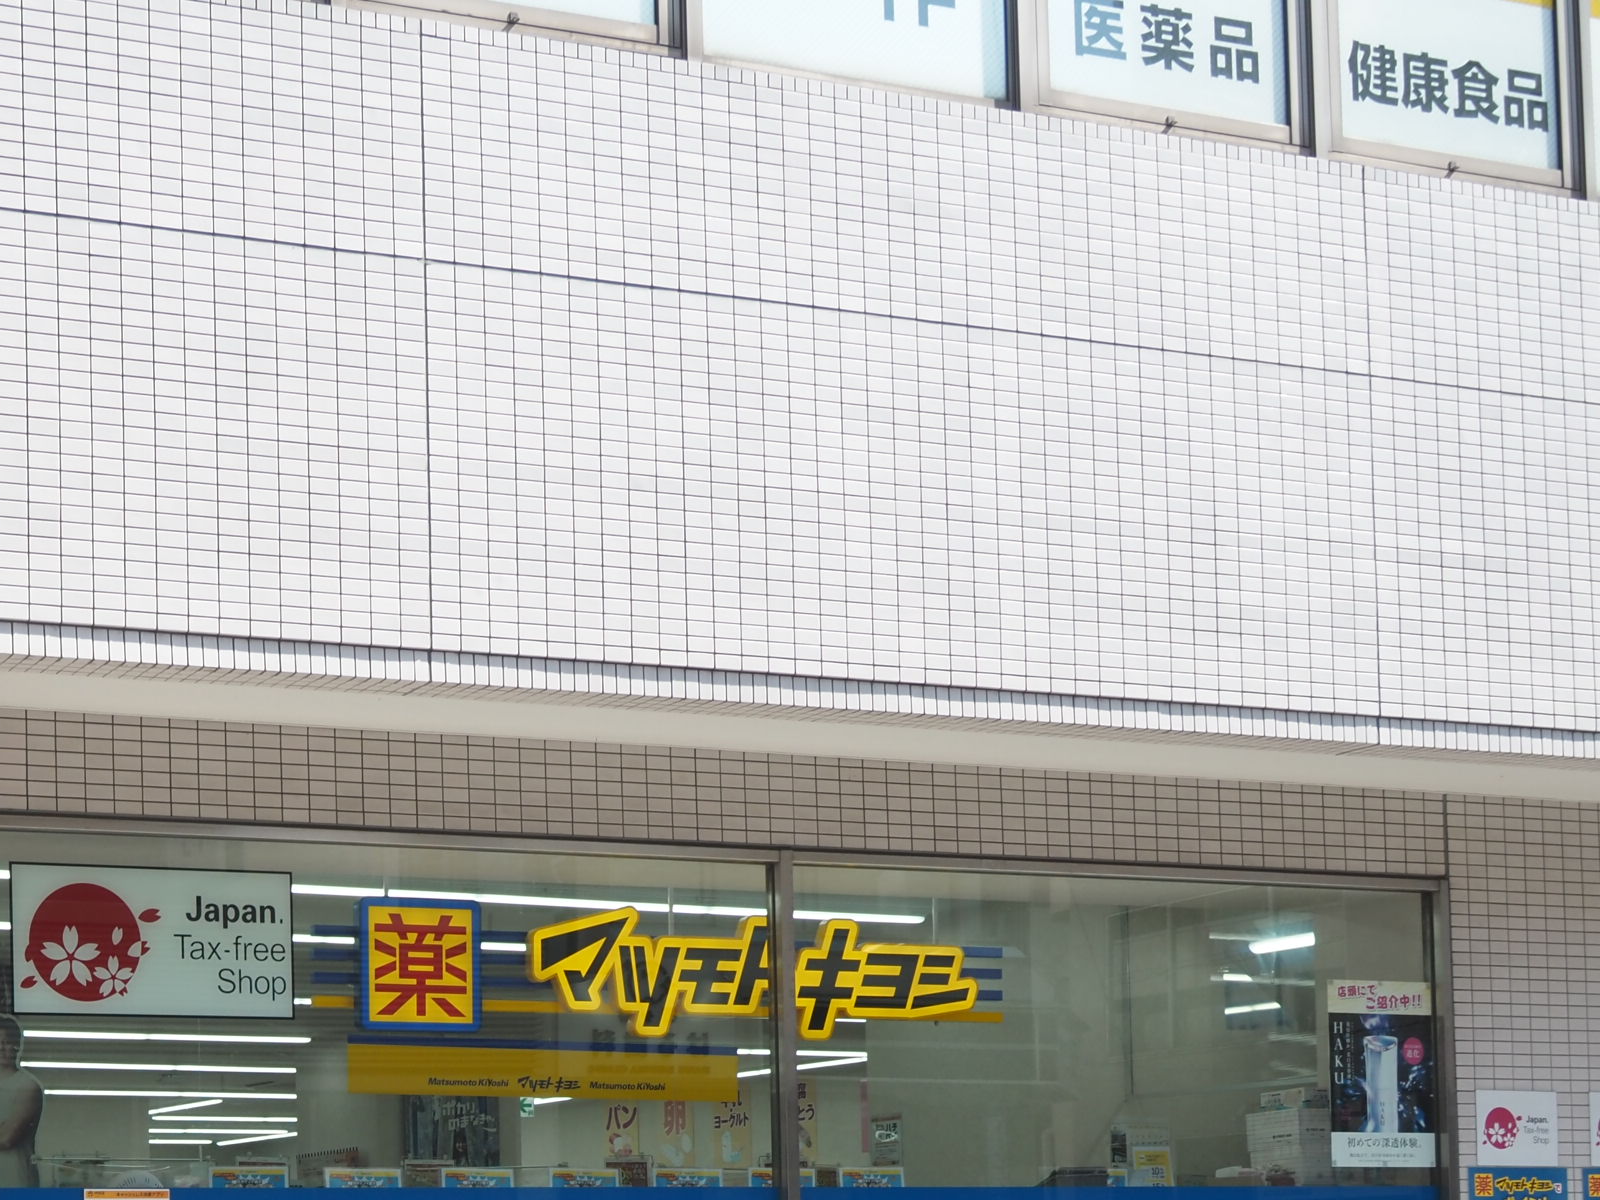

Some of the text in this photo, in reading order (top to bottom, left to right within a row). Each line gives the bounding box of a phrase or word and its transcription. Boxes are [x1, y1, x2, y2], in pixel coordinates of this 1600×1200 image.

[1075, 1, 1259, 83] 医薬品
[1347, 40, 1548, 132] 健康食品
[185, 896, 284, 929] Japan.
[174, 934, 286, 961] Tax-free
[372, 912, 468, 1017] 薬
[529, 906, 978, 1040] マツモトキヨシ
[218, 968, 286, 1000] Shop
[1338, 985, 1377, 997] 店頭にて
[1333, 1021, 1344, 1085] HAKU
[428, 1077, 477, 1086] Matsumoto
[589, 1081, 636, 1090] Matsumoto
[606, 1105, 637, 1131] パン
[714, 1112, 749, 1129] ヨーグルト
[1533, 1136, 1549, 1145] Shop
[1474, 1173, 1494, 1196] 薬
